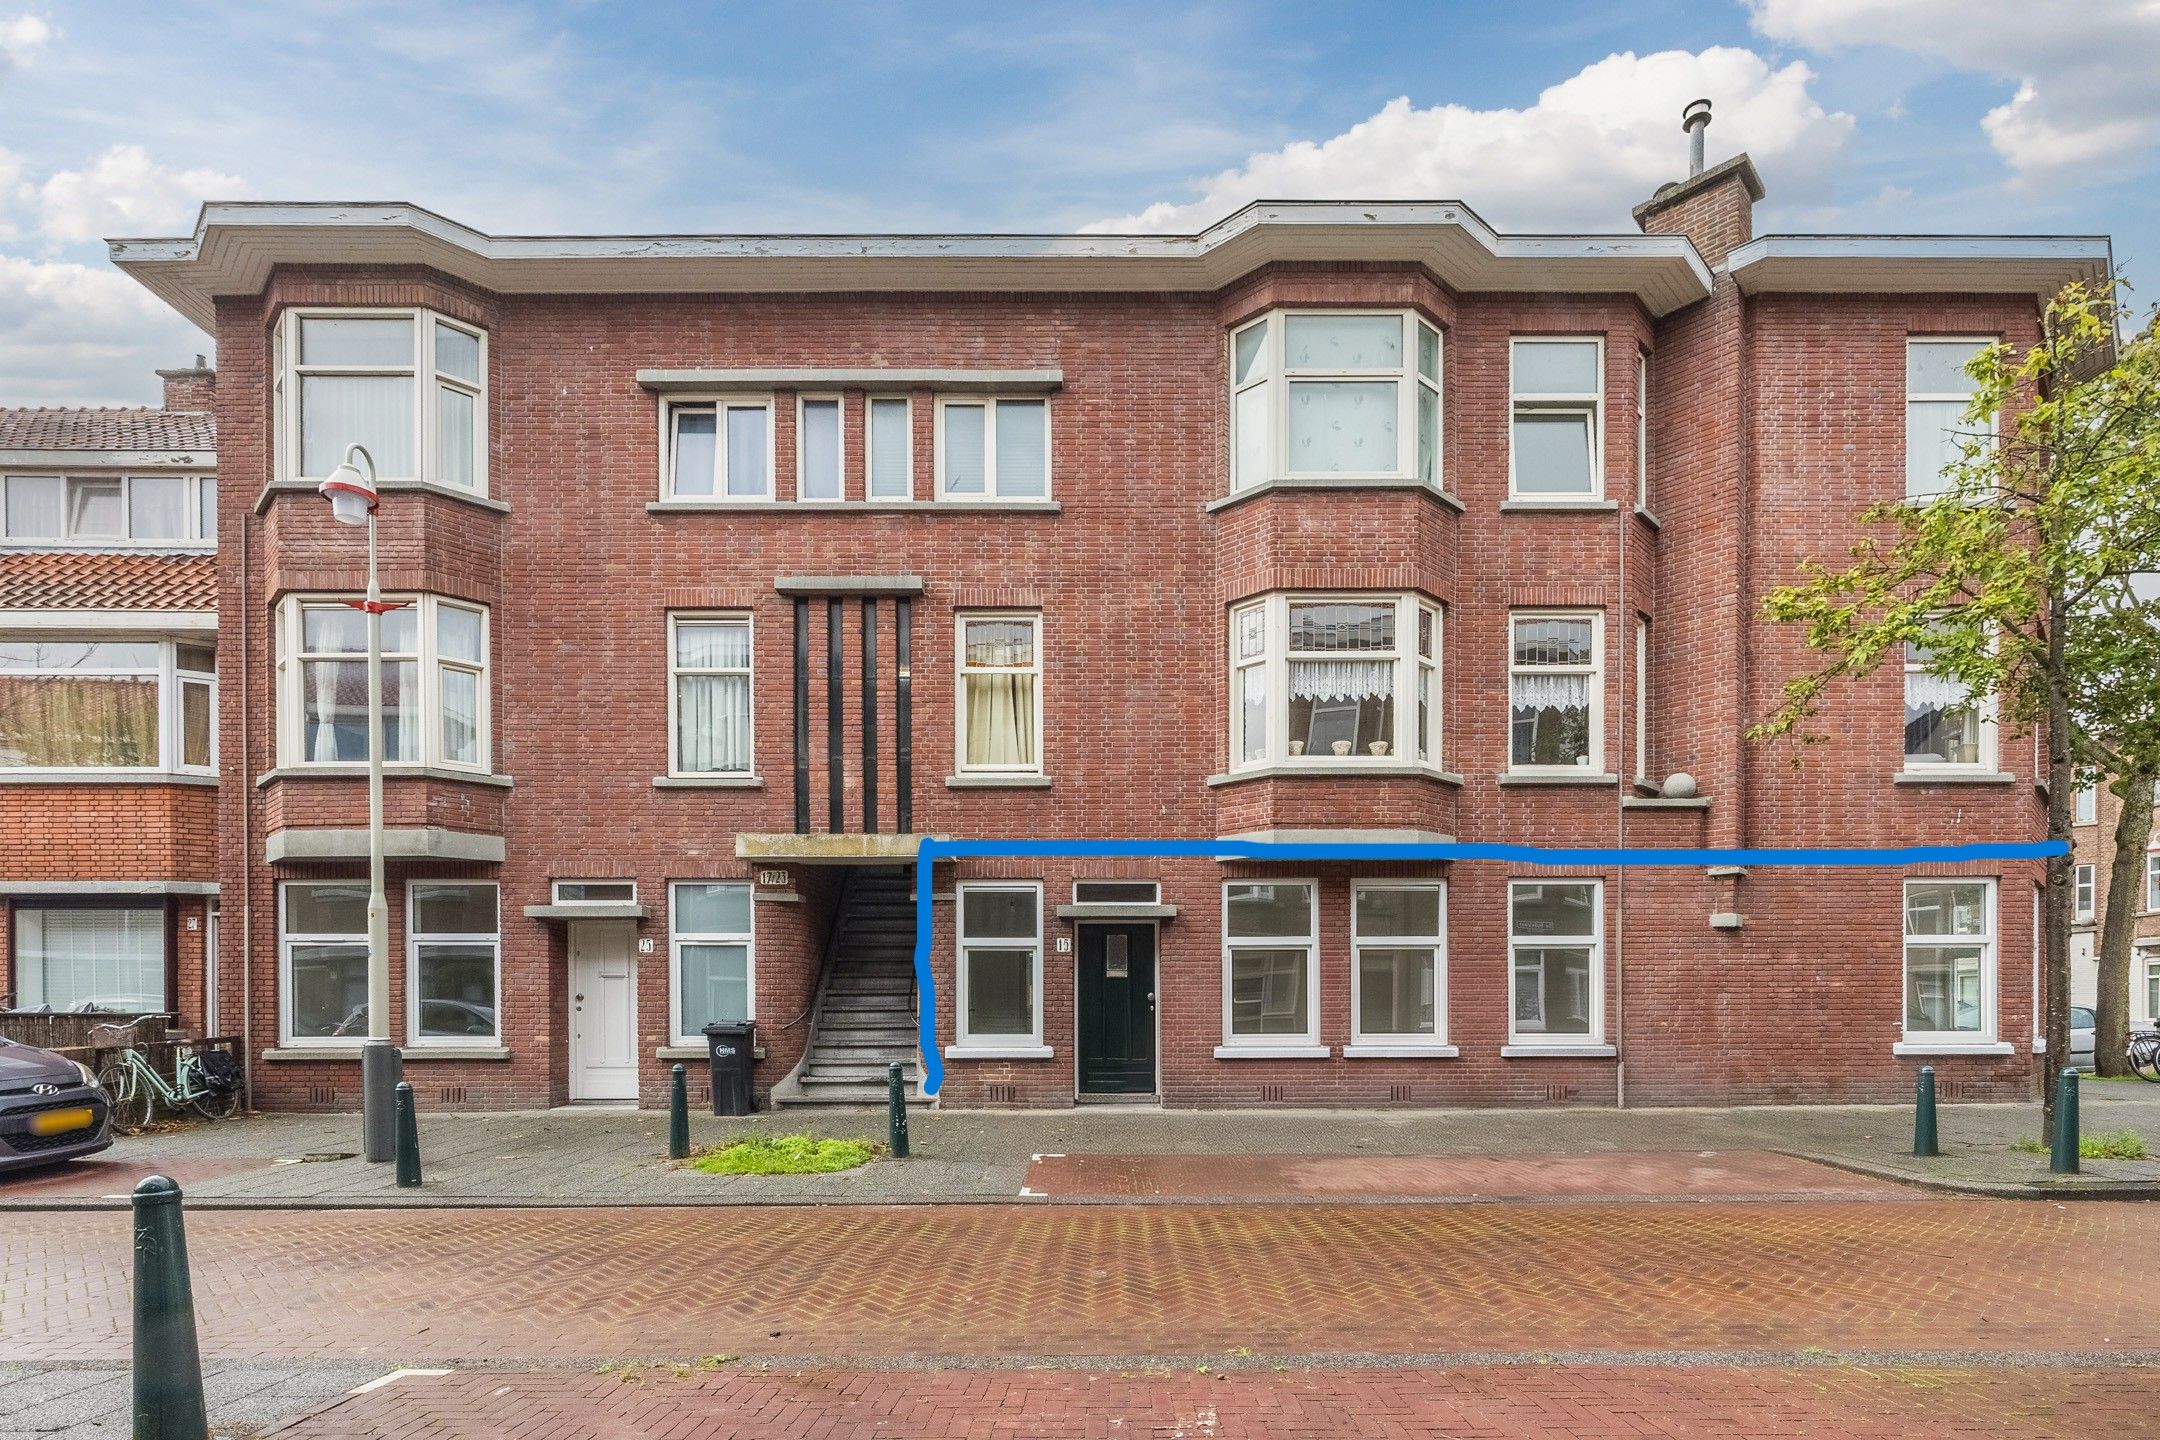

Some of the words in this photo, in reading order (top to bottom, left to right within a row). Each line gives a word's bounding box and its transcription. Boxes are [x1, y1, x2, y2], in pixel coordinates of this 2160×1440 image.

[762, 871, 786, 884] 17/23
[640, 940, 651, 951] 25
[1059, 939, 1069, 951] 15
[719, 1047, 735, 1055] HMS
